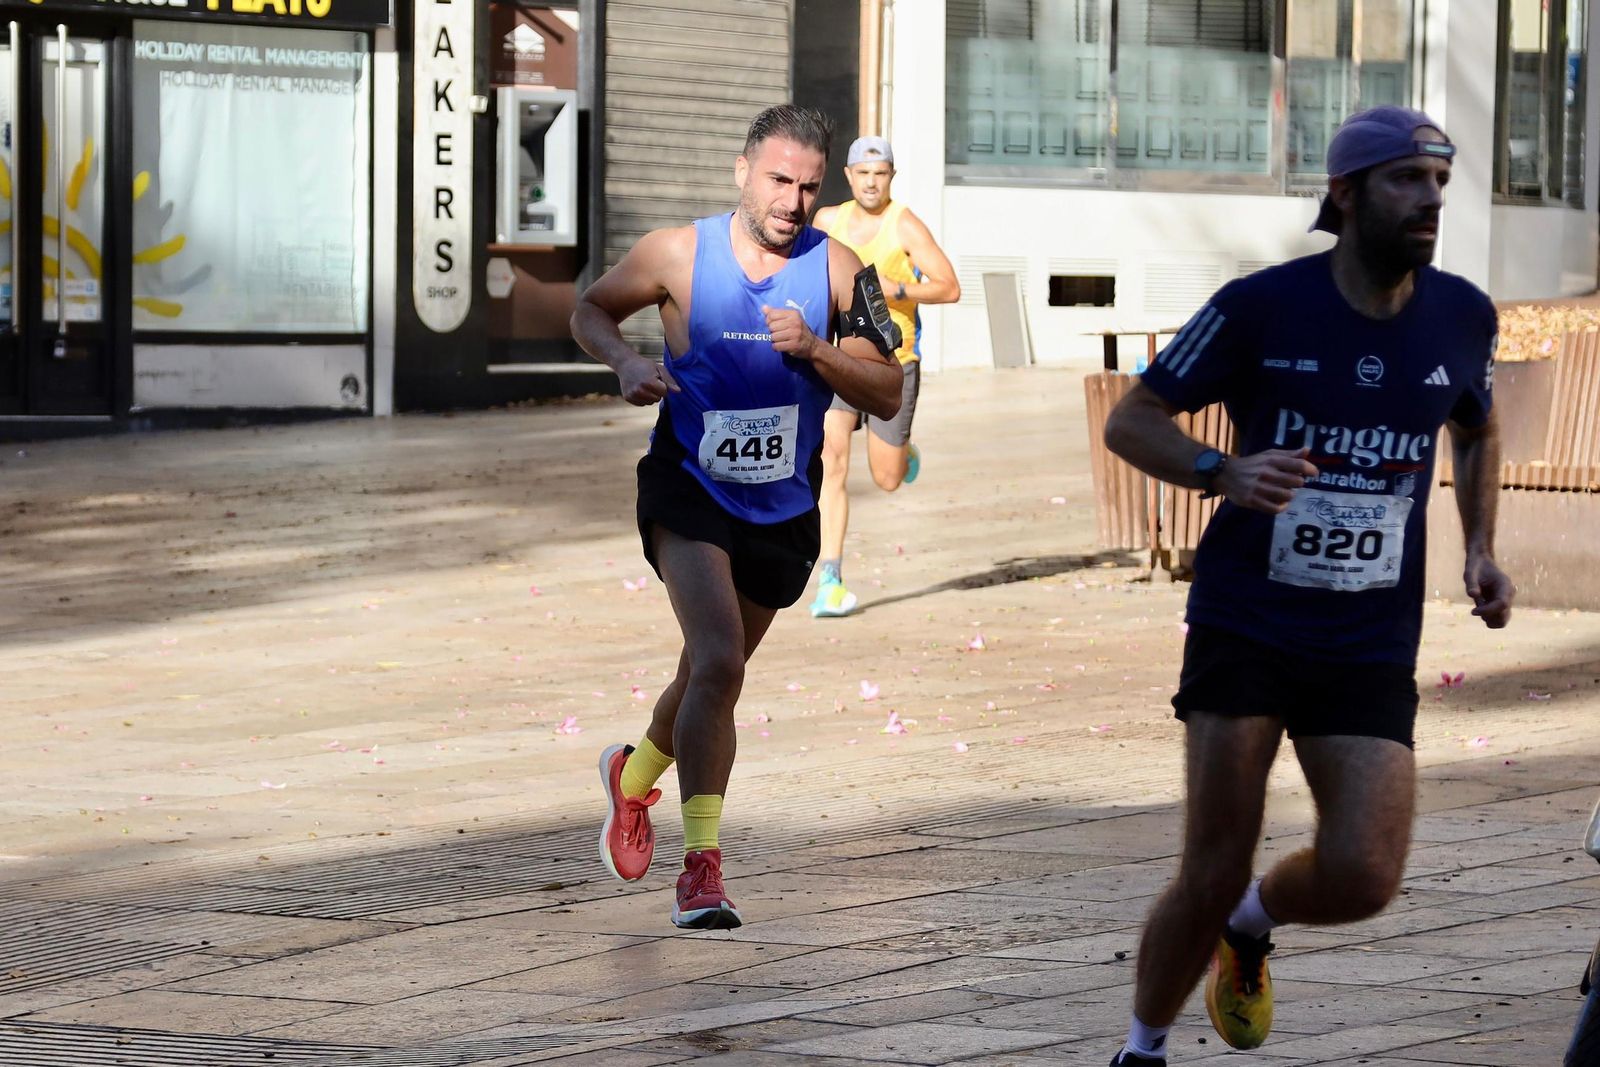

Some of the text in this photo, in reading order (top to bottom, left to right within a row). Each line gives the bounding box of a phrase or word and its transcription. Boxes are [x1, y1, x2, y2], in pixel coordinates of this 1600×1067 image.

[134, 40, 367, 69] HOLIDAY RENTAL MANAGEMENT
[434, 0, 454, 273] AKERS
[427, 287, 457, 298] SHOP
[716, 435, 783, 462] 448
[1274, 408, 1430, 468] Prague
[1293, 524, 1383, 561] 820
